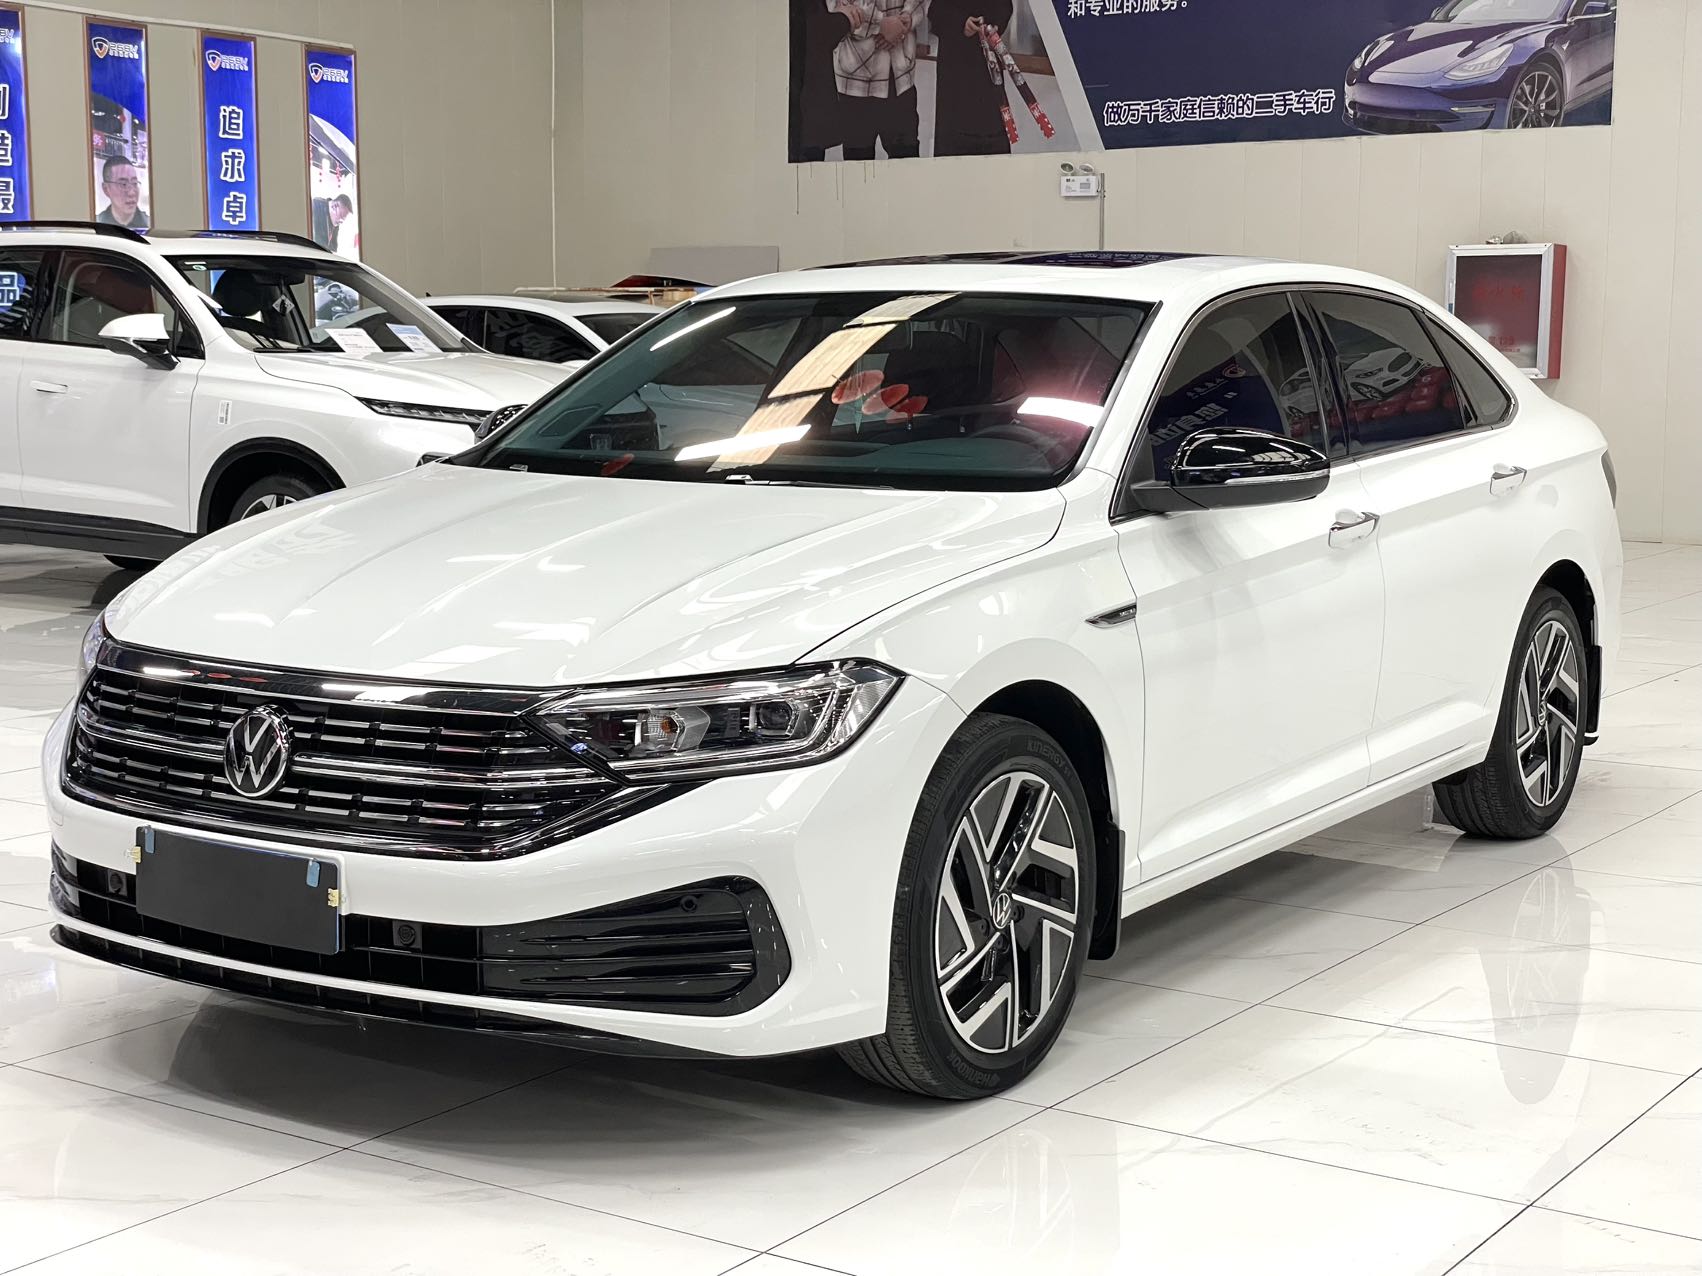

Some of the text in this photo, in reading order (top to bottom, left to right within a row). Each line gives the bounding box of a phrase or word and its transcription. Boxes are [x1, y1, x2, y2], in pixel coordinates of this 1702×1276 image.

[1103, 88, 1336, 126] 做万千家庭信赖的二手车行
[219, 105, 247, 225] 追求卓
